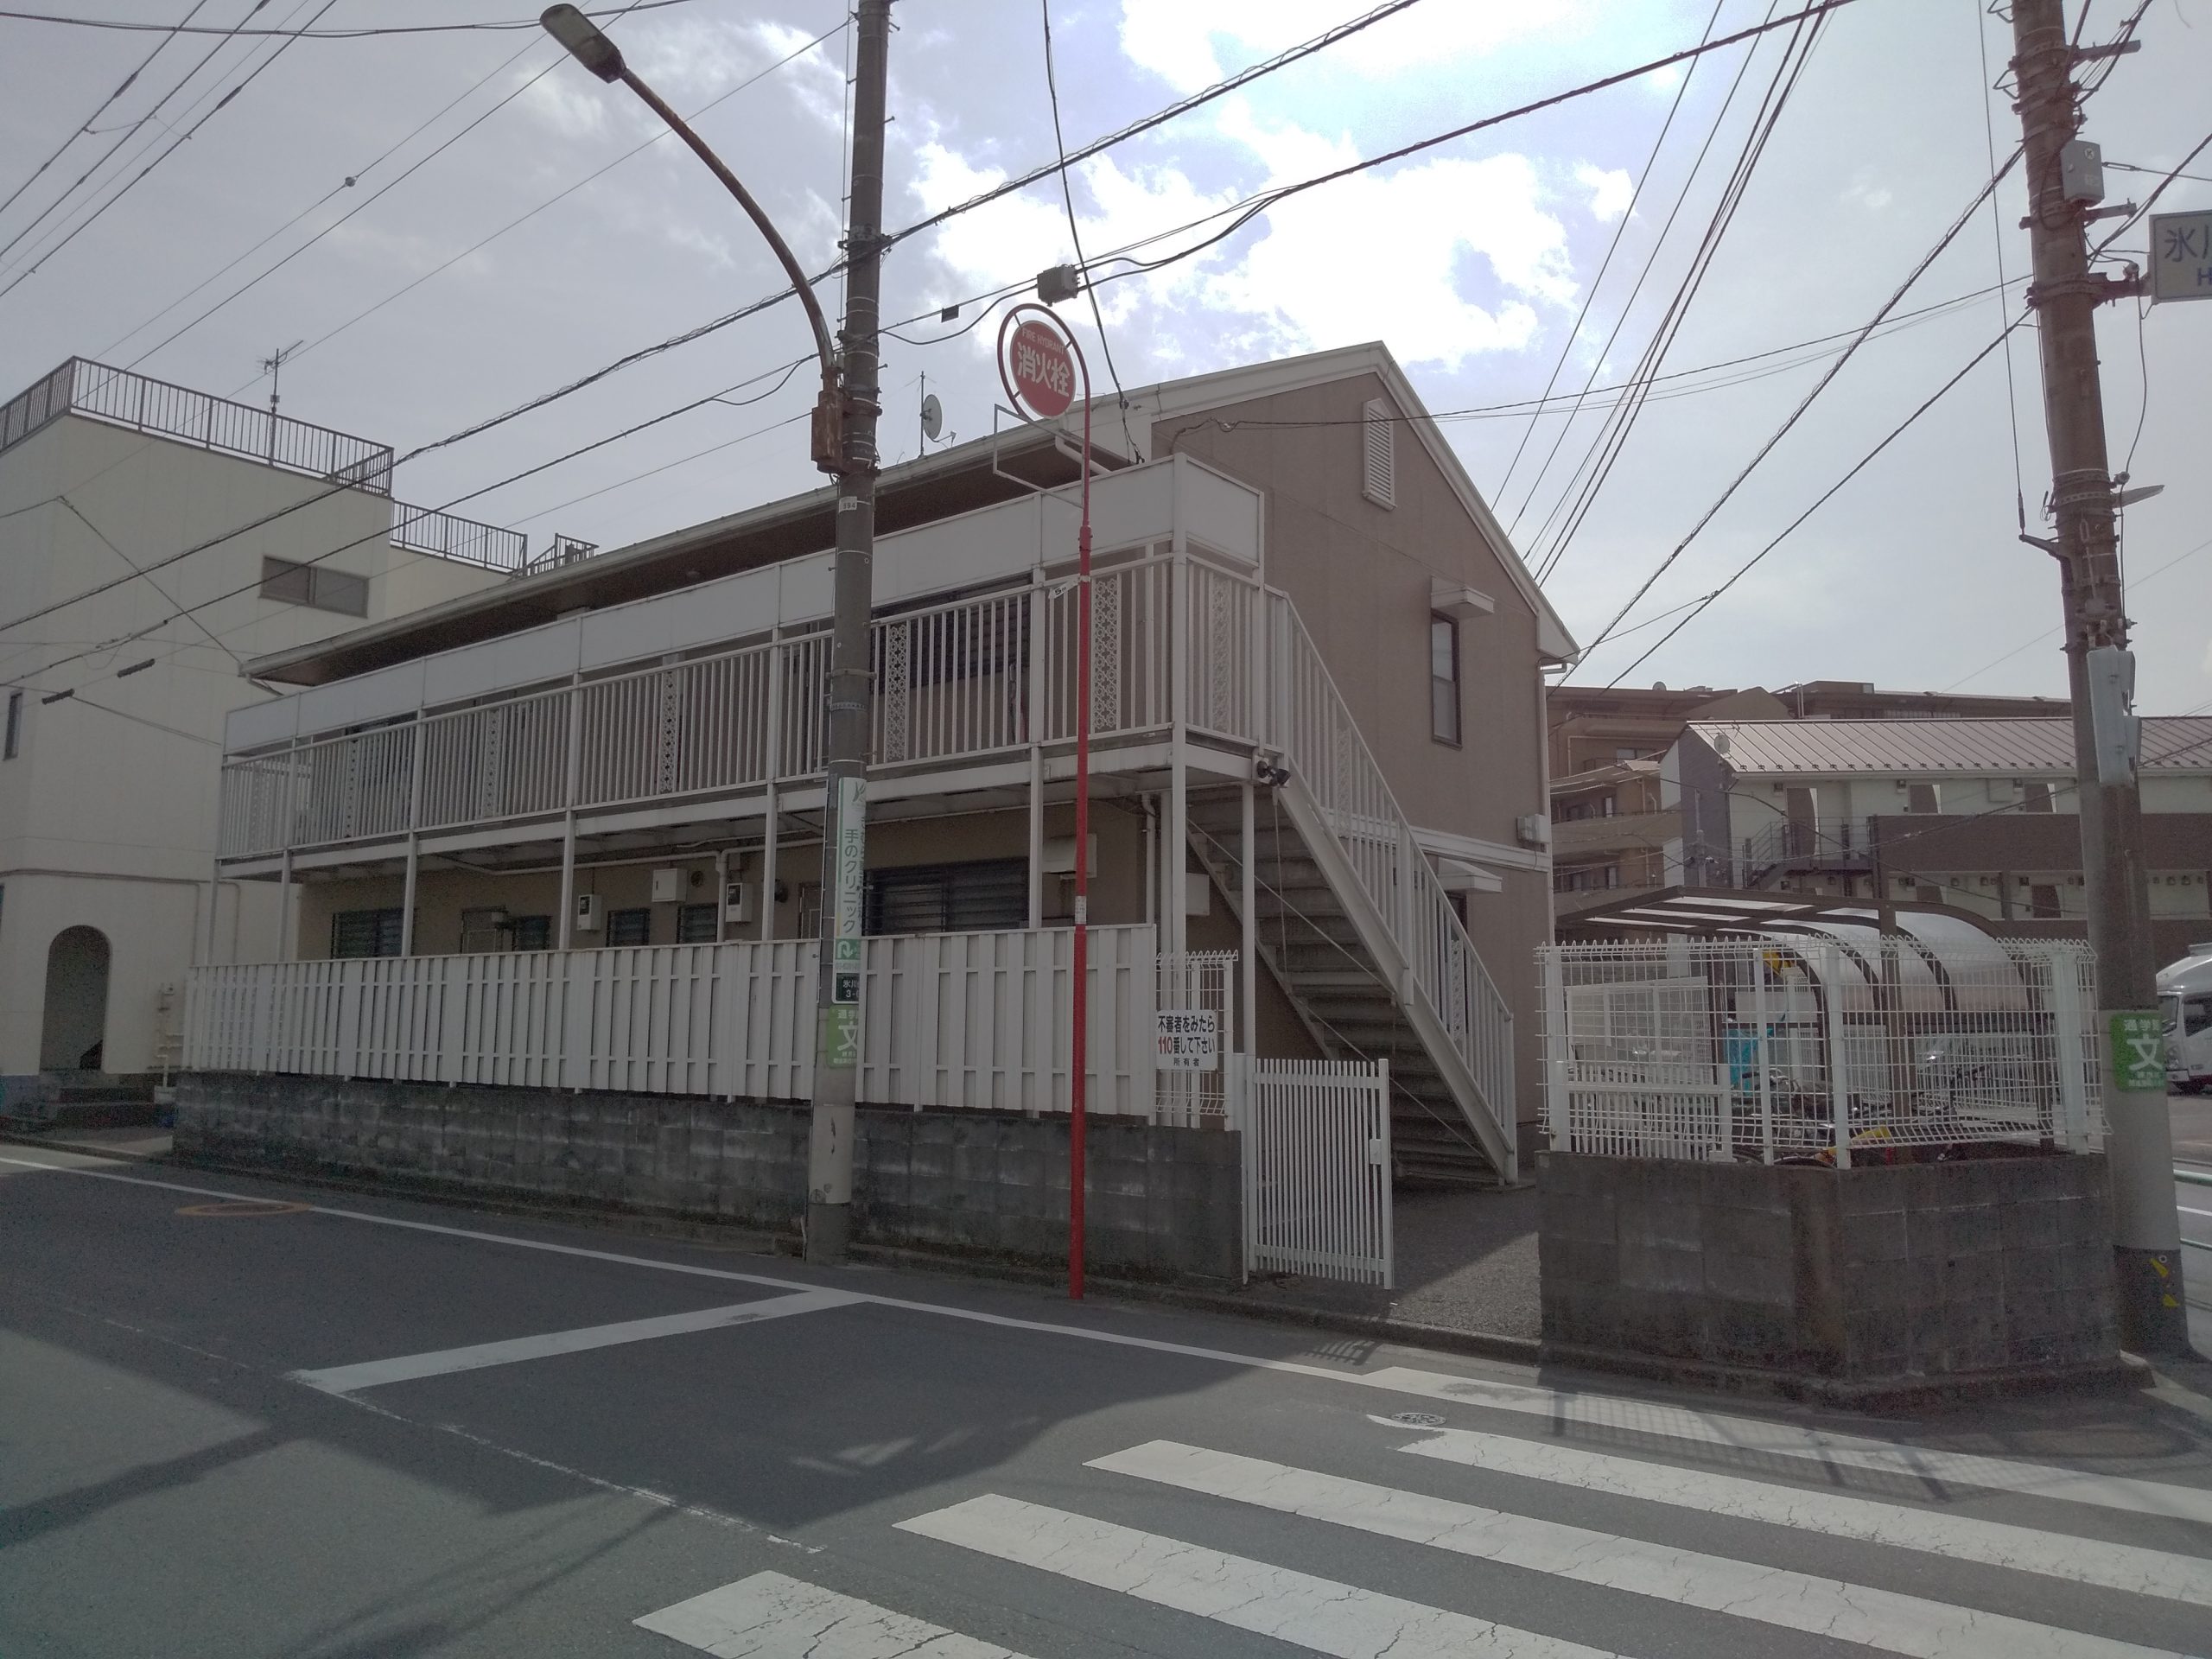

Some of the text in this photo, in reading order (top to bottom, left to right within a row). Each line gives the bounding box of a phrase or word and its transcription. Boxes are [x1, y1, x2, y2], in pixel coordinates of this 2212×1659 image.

[1022, 327, 1065, 355] FIRE HYDRANT
[1017, 341, 1070, 397] 消火栓
[843, 829, 860, 933] 手のクリニック
[838, 1009, 858, 1020] 通学
[1158, 1014, 1216, 1033] 不審者をみたら
[837, 1020, 858, 1052] 文
[1158, 1036, 1216, 1054] 110番して下さい
[1173, 1057, 1200, 1067] 所有者
[2126, 1033, 2164, 1071] 文
